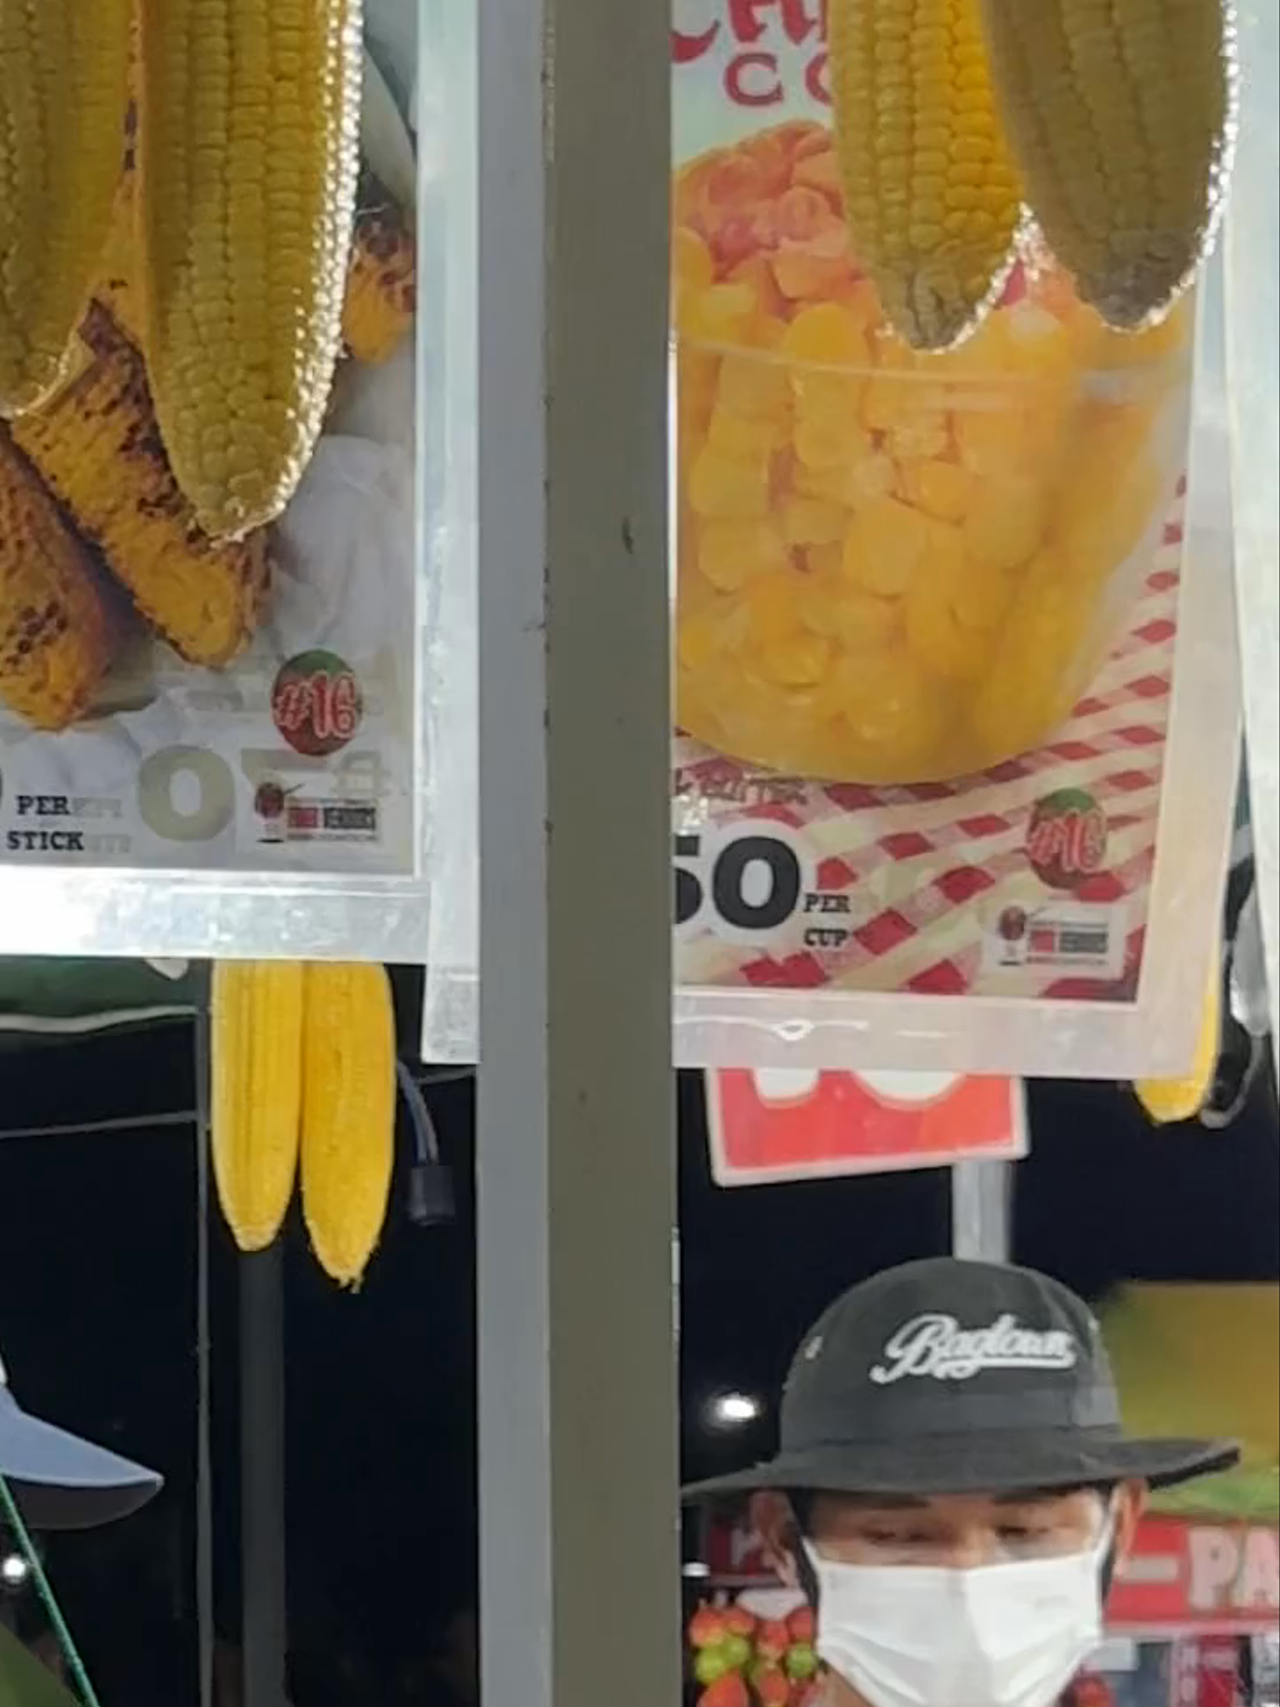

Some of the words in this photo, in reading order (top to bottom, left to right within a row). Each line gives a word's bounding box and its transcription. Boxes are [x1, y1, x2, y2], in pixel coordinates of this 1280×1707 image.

[15, 794, 71, 816] PER
[6, 830, 85, 852] STICK
[803, 893, 851, 913] PER
[803, 928, 849, 947] CUP
